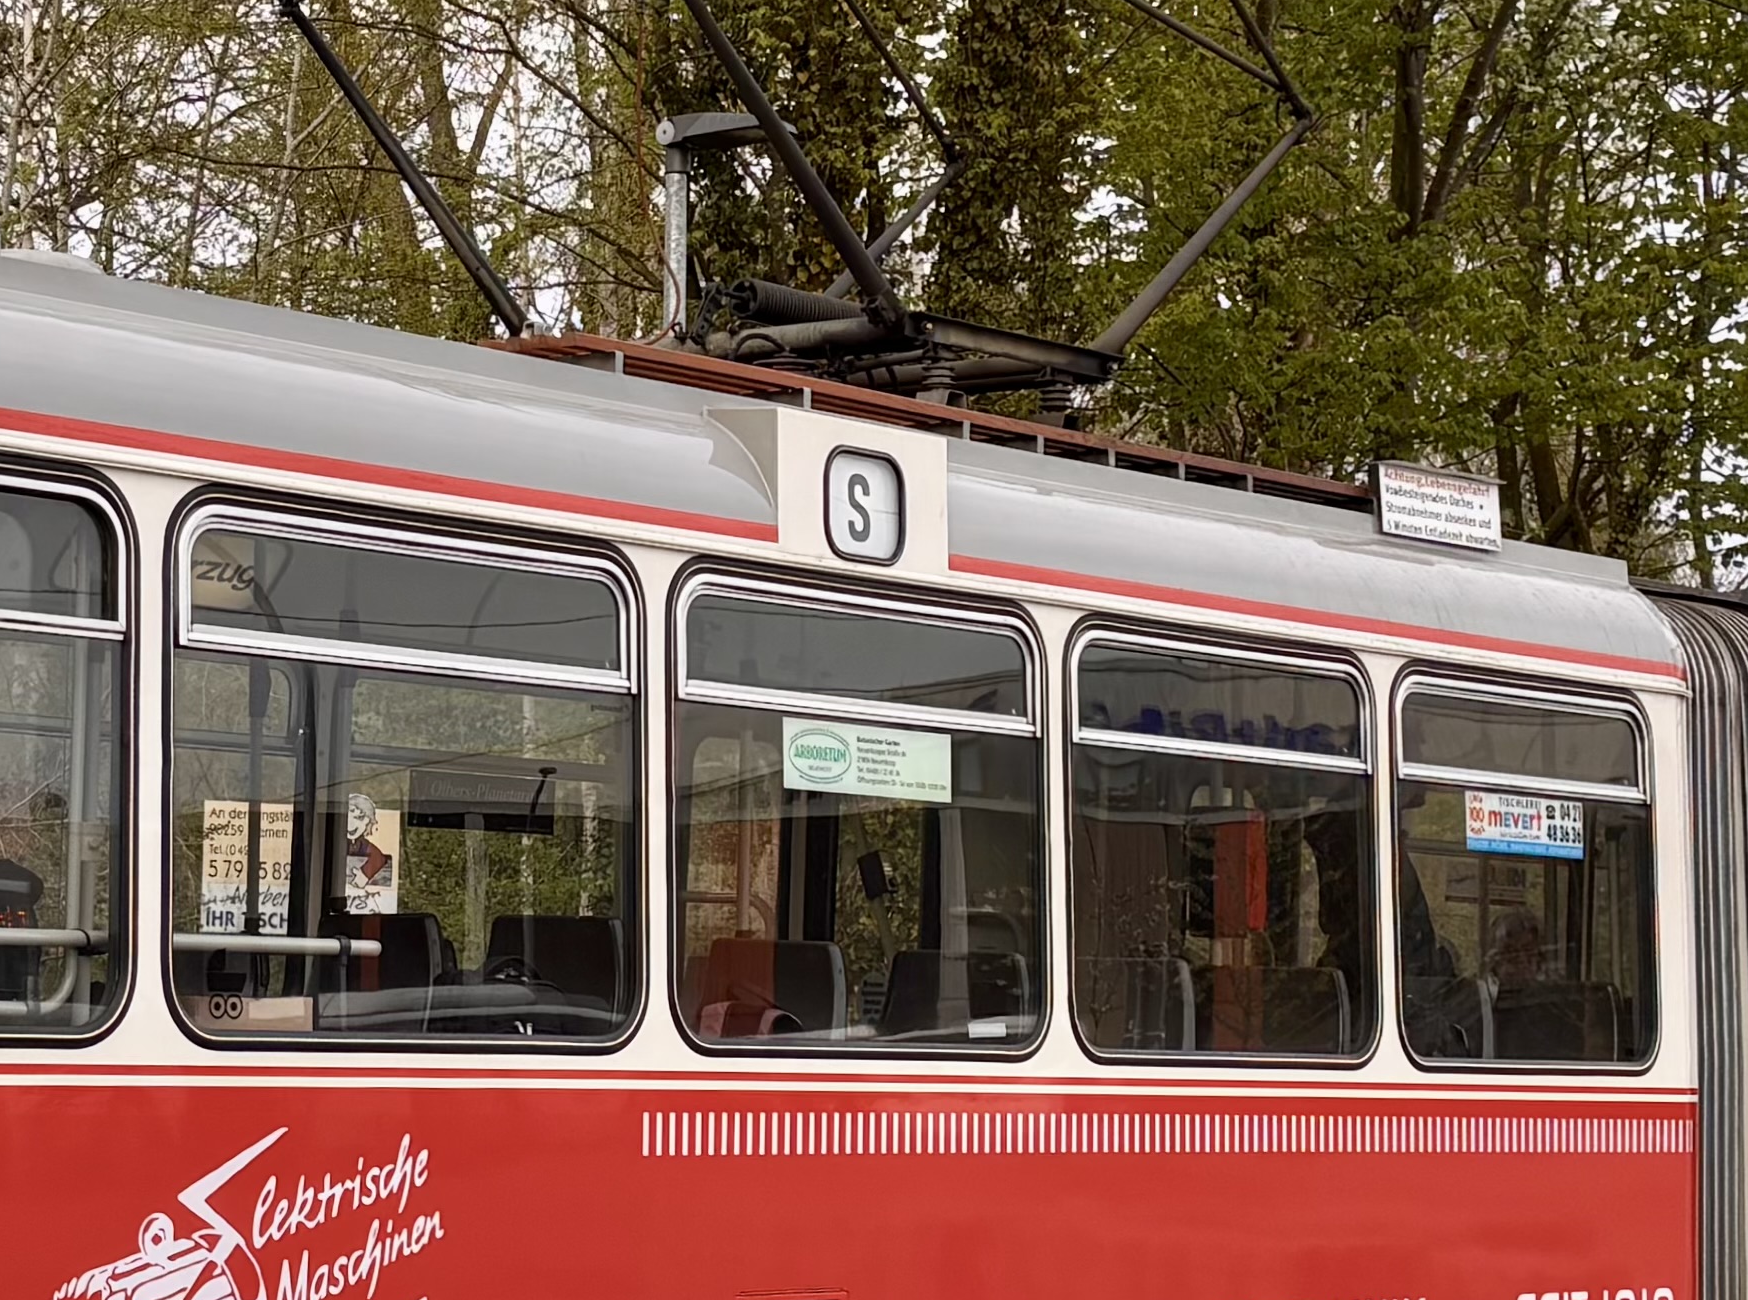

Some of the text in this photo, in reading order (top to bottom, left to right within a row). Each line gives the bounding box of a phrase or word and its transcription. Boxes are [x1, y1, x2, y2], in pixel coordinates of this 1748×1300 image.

[847, 473, 870, 542] S
[794, 744, 847, 763] ARBORETUM
[209, 807, 225, 819] An
[229, 807, 247, 819] der
